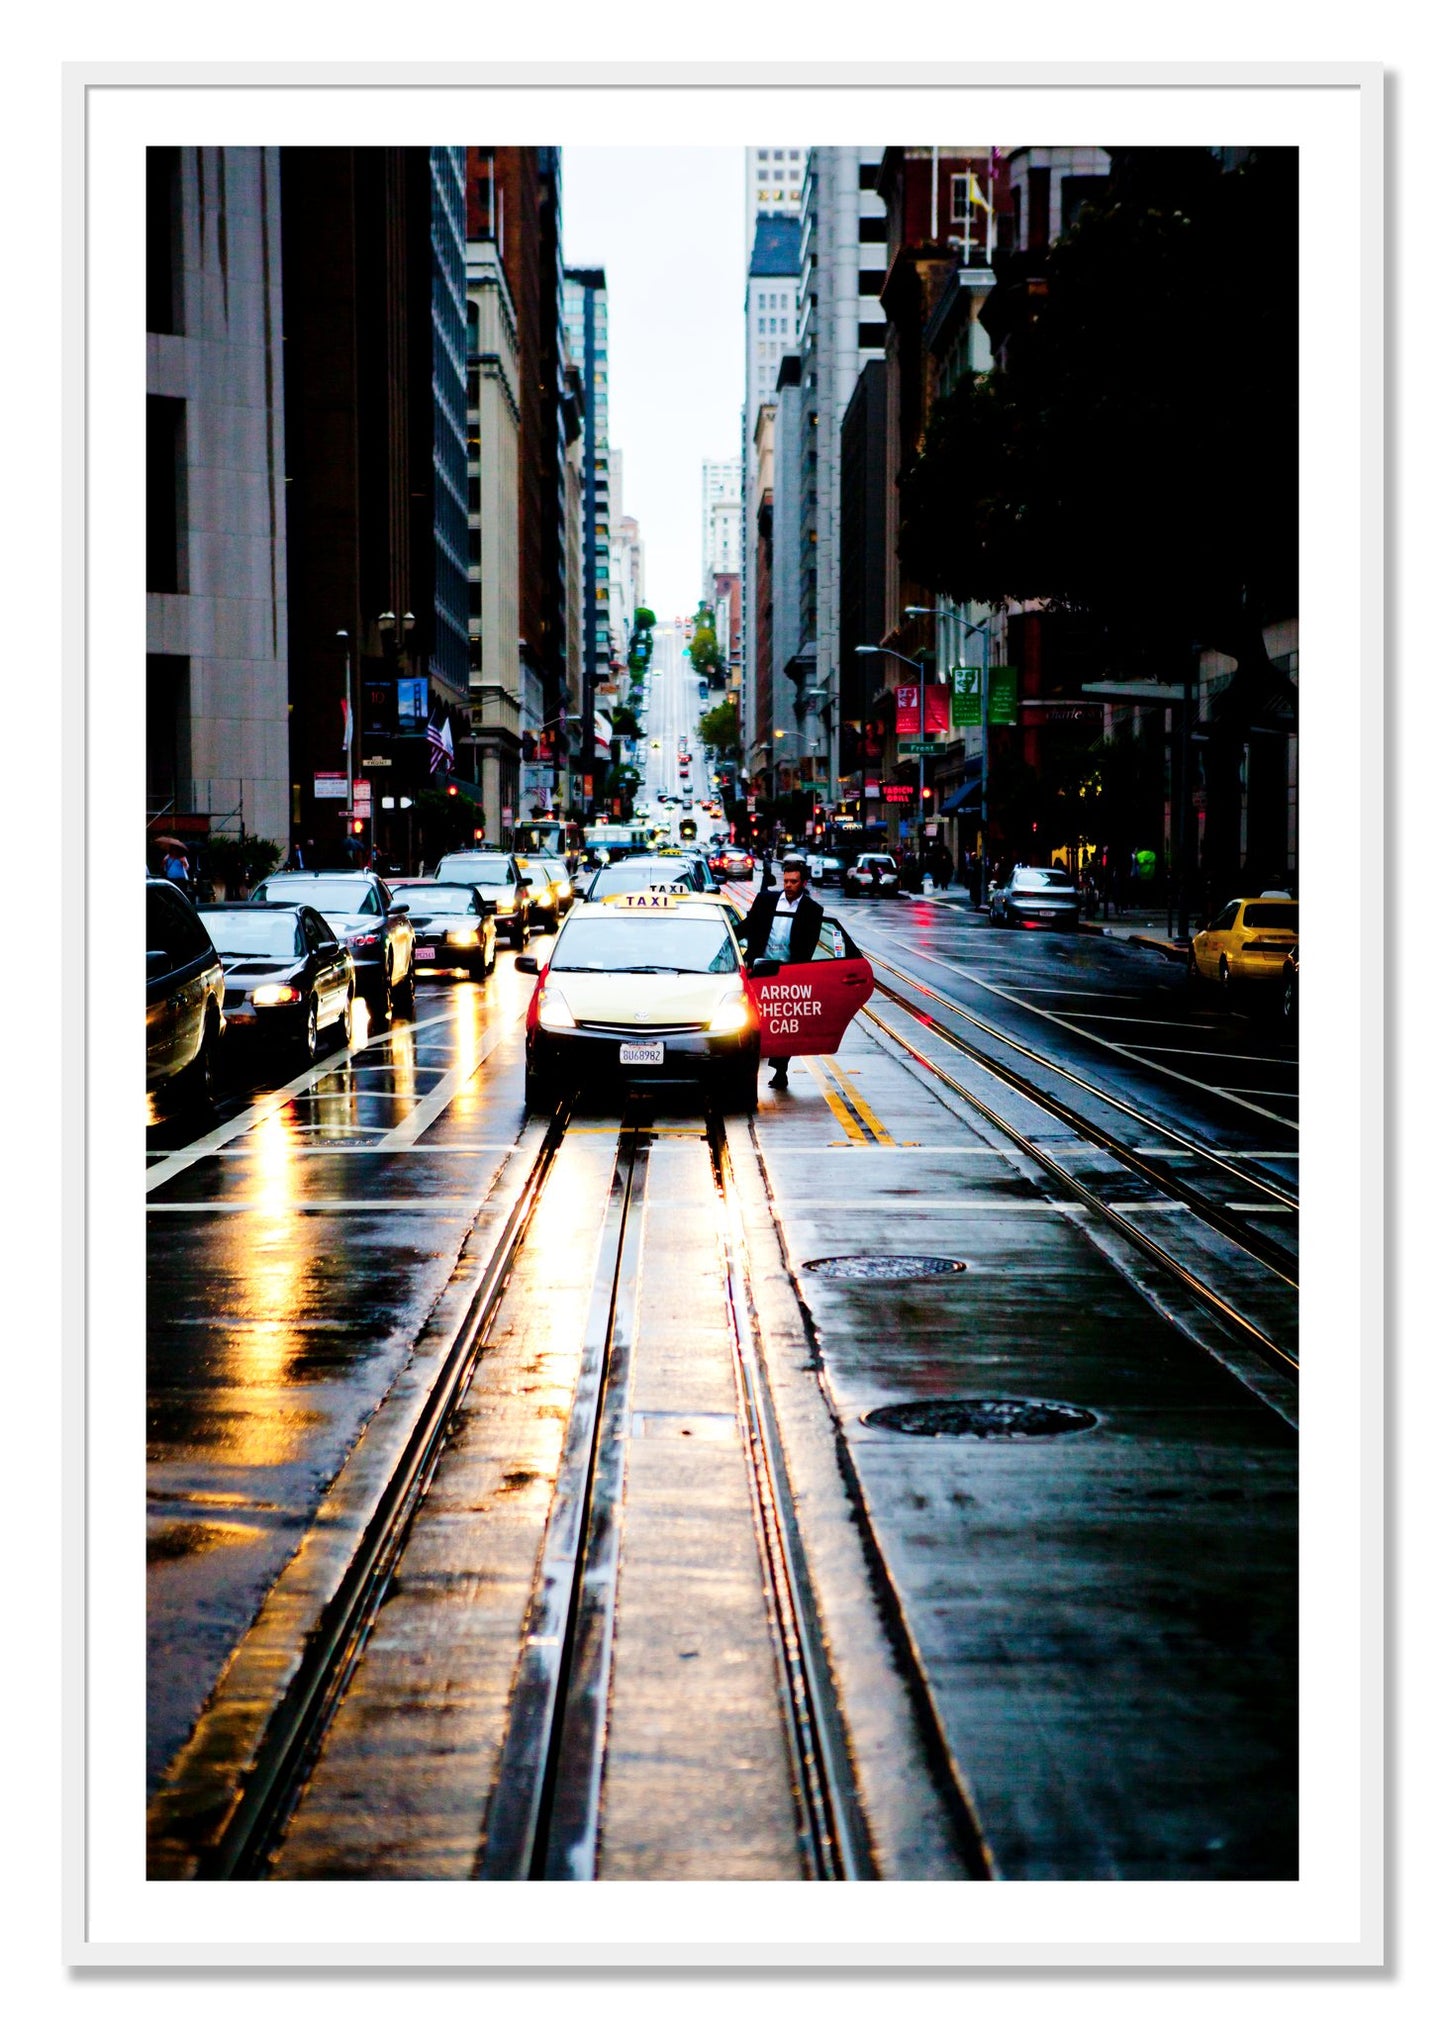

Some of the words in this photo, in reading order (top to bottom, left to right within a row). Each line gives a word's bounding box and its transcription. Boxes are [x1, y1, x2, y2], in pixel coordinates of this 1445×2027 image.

[650, 885, 684, 893] TAXI
[626, 896, 668, 906] TAXI
[760, 984, 812, 999] ARROW
[769, 1019, 799, 1034] CAB
[622, 1050, 661, 1061] 8U68982
